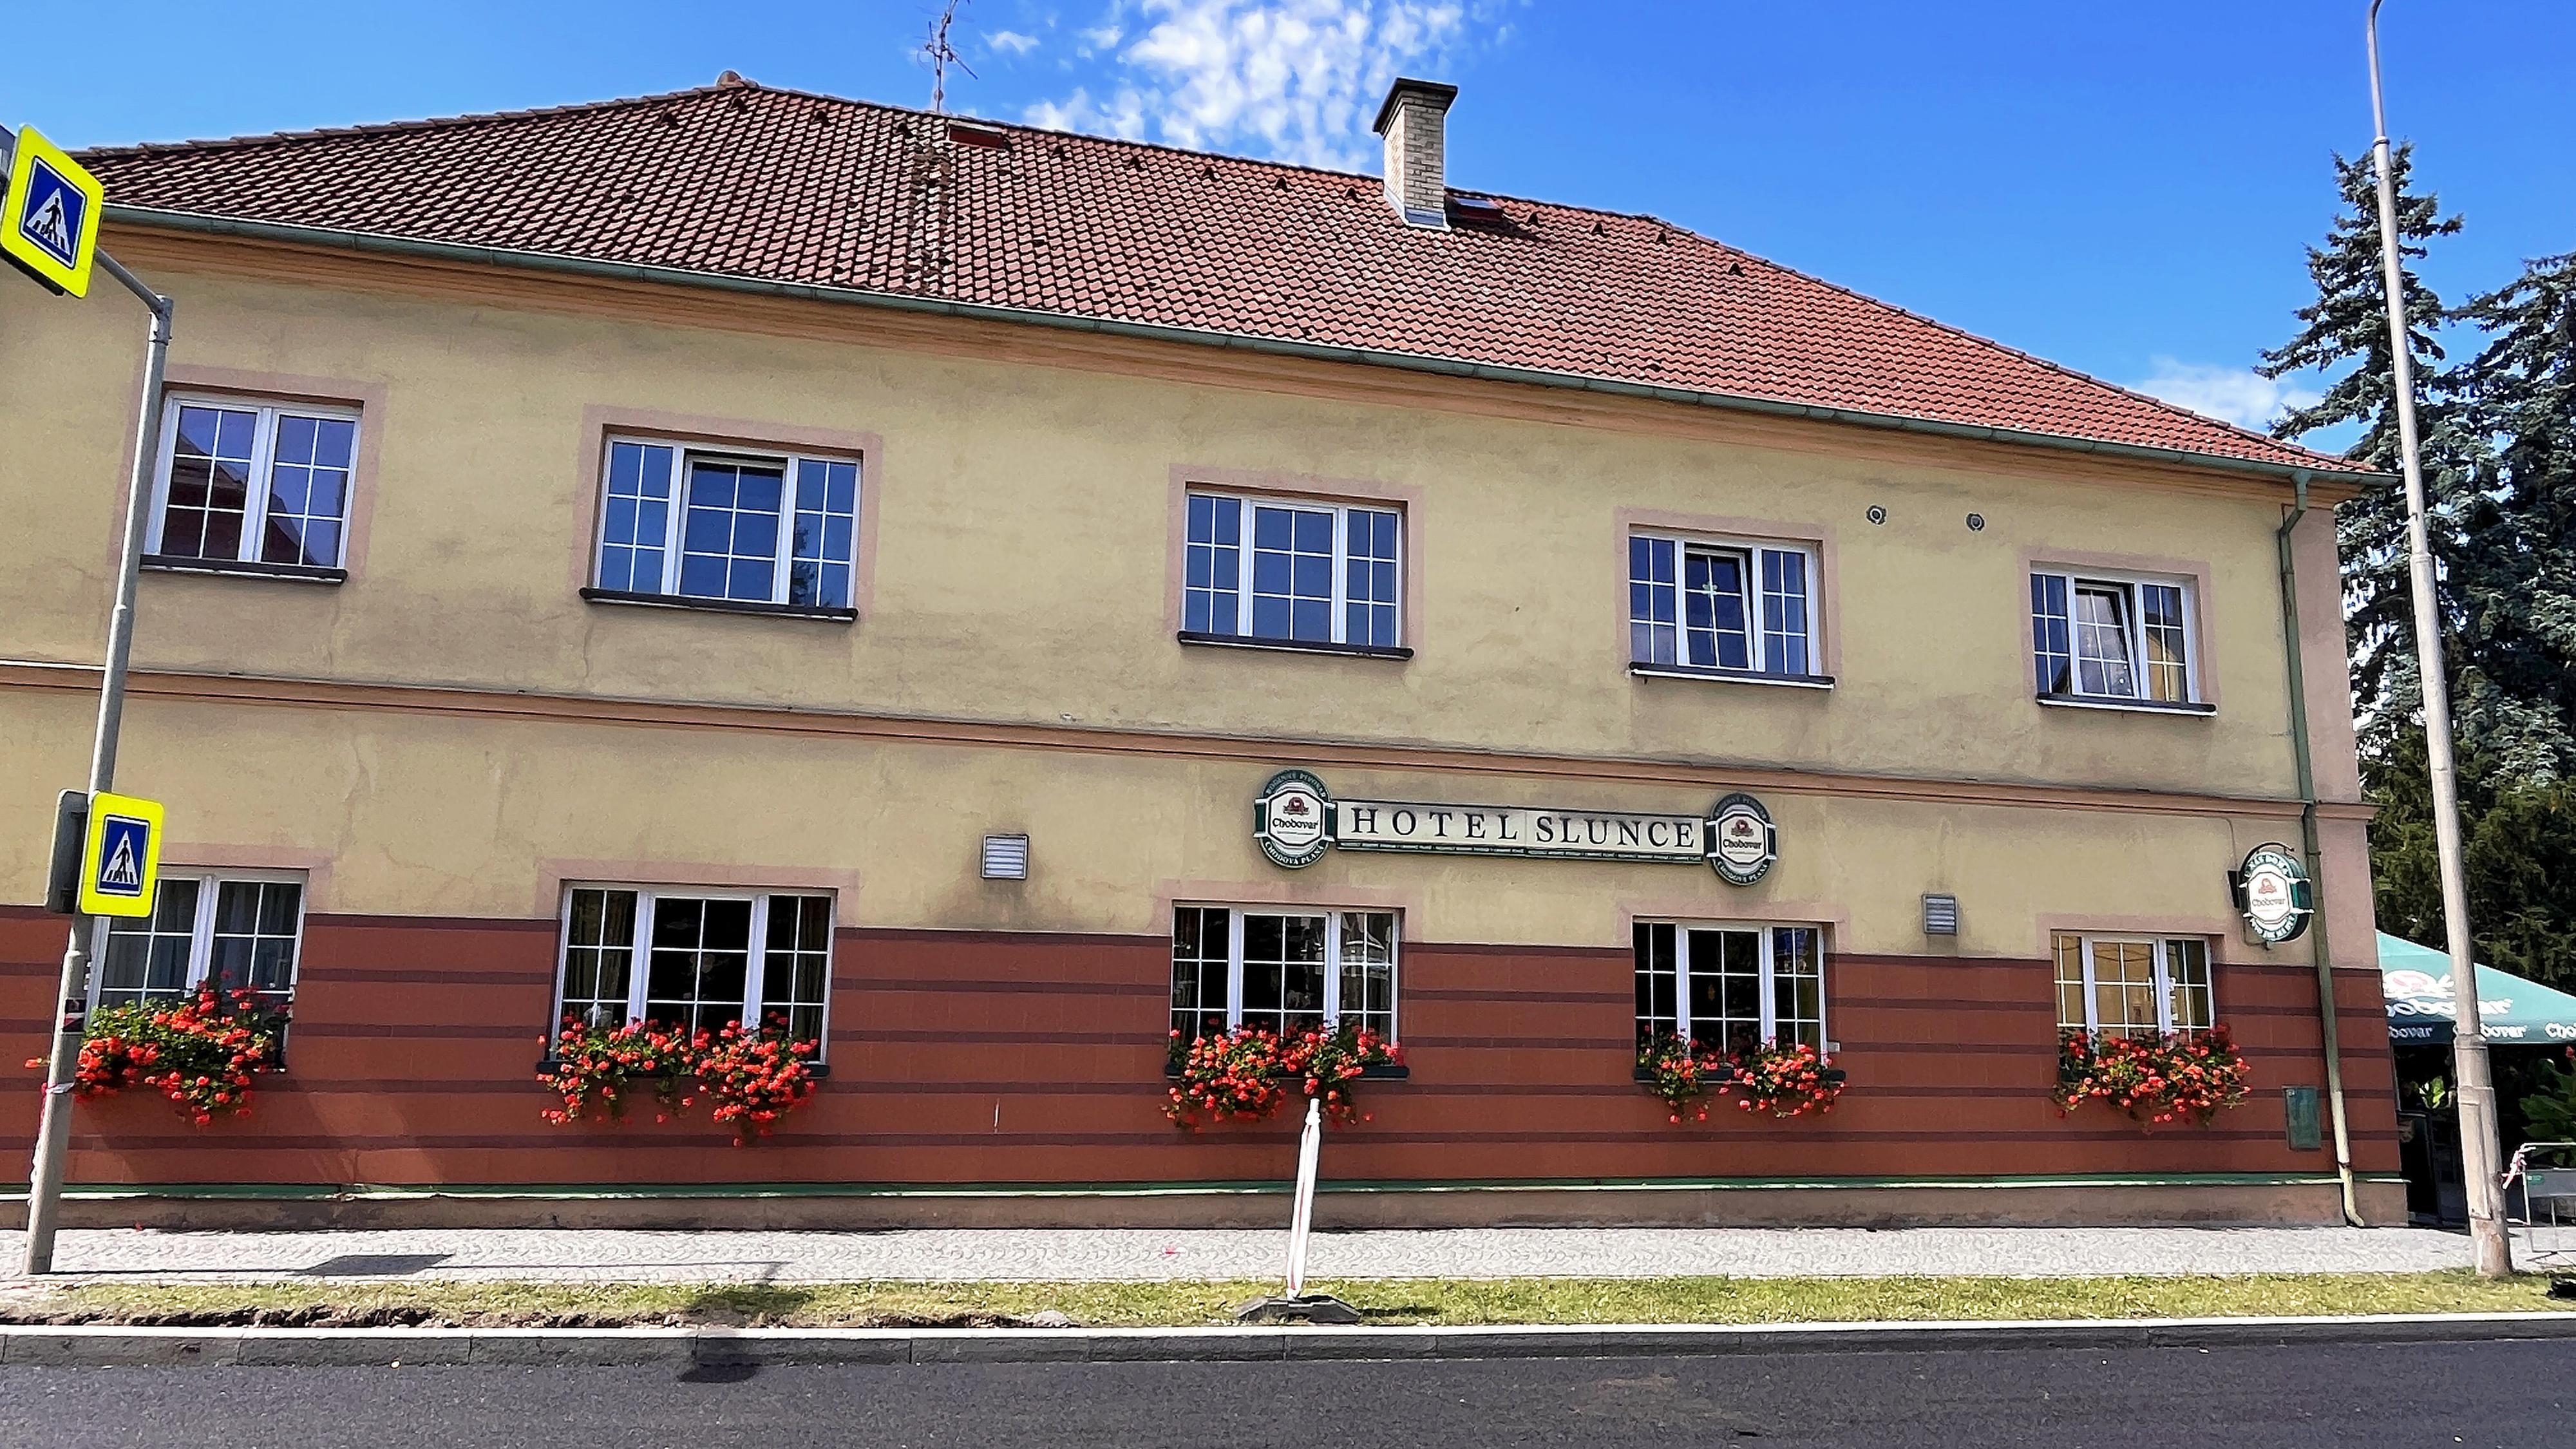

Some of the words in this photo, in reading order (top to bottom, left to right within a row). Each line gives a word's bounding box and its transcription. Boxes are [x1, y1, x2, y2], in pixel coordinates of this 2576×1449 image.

[1272, 818, 1319, 829] Chodovar
[1351, 808, 1518, 840] HOTEL
[1536, 816, 1694, 848] SLUNCE
